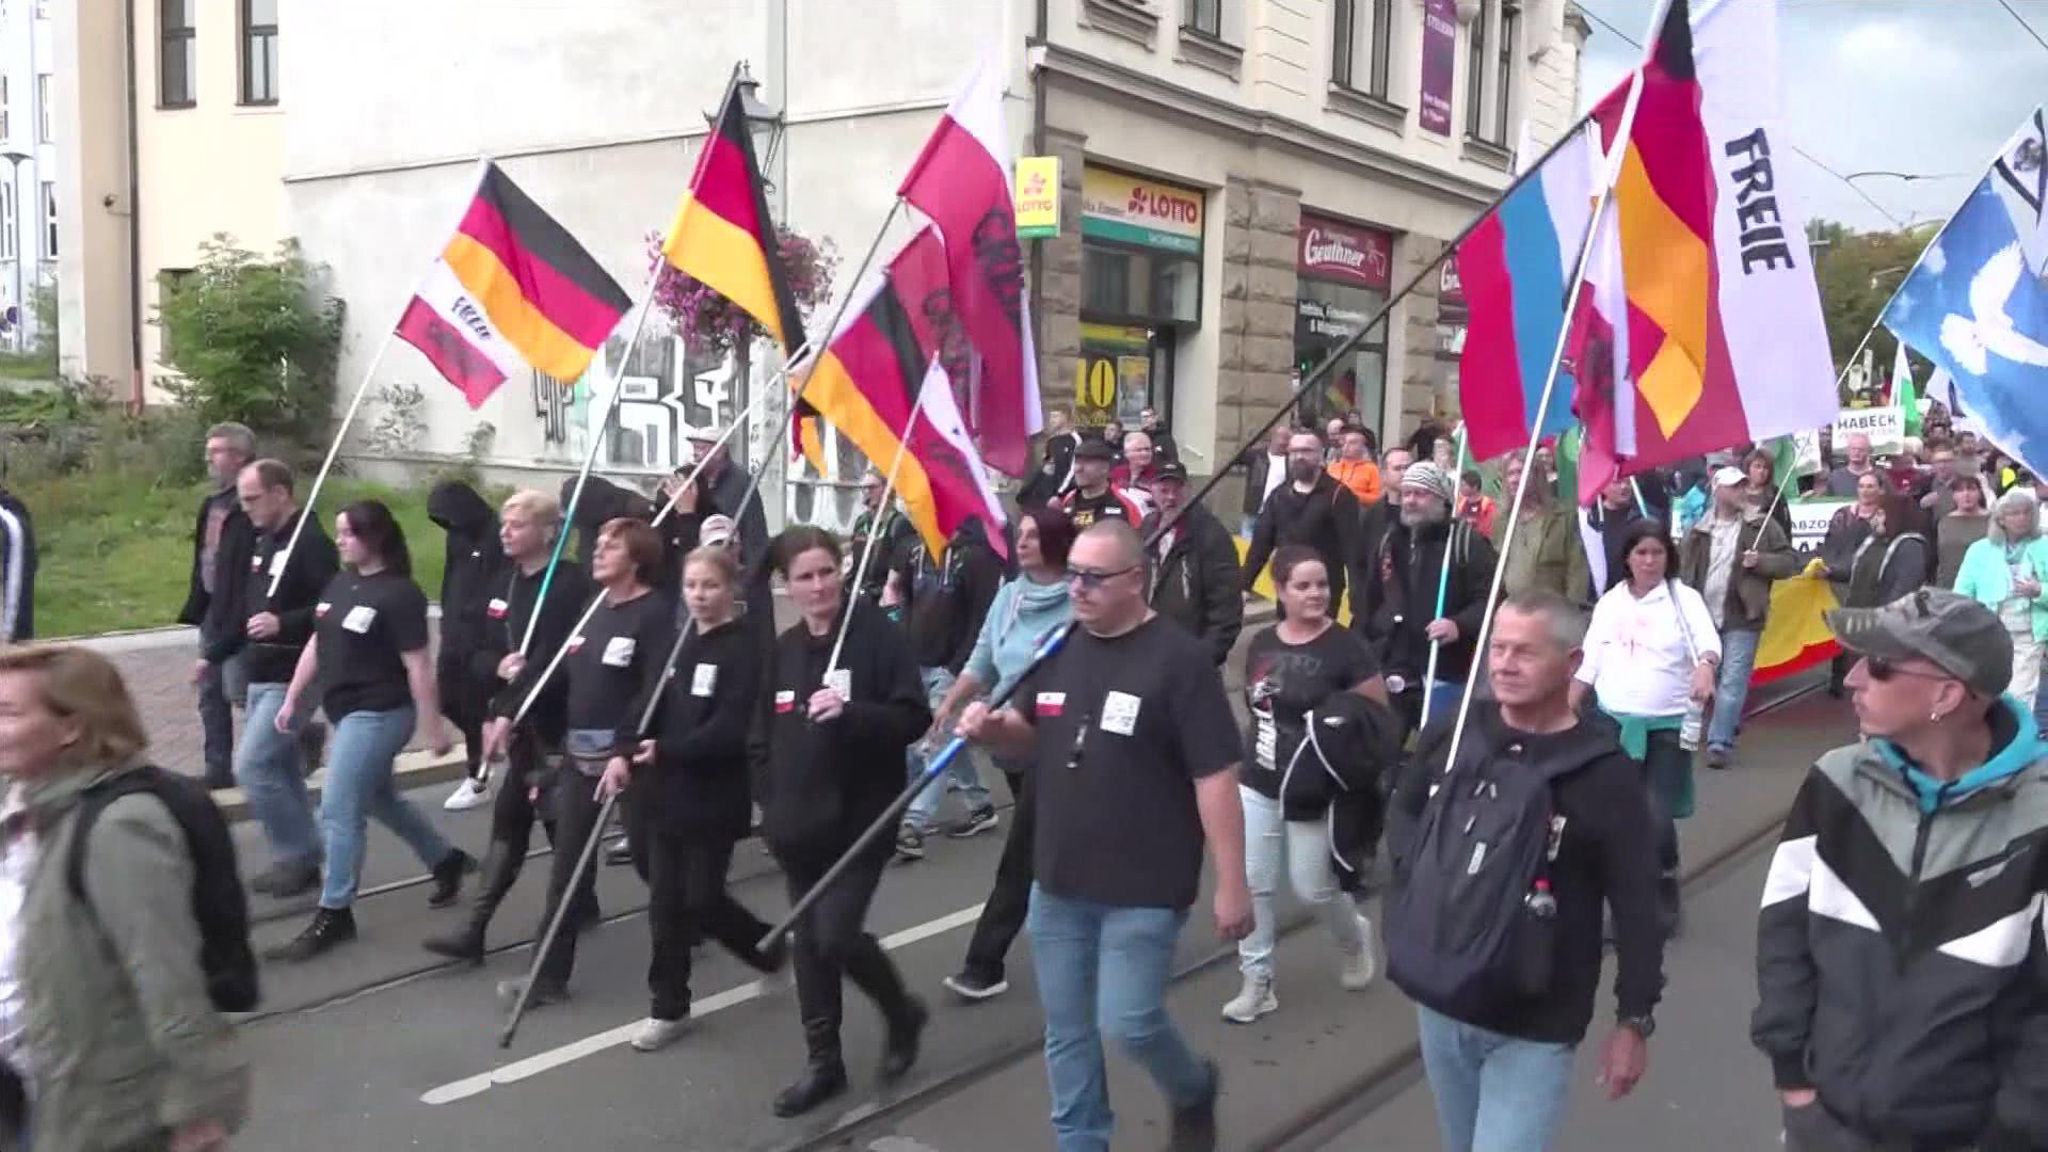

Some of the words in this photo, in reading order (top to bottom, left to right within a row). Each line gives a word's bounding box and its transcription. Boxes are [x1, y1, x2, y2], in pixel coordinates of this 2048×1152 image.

[1017, 200, 1053, 214] LOTTO
[1150, 192, 1198, 224] LOTTO
[1725, 128, 1794, 275] FREIE
[1304, 228, 1365, 267] Geuthner
[1837, 414, 1898, 430] HABECK
[1791, 519, 1828, 530] ABZO
